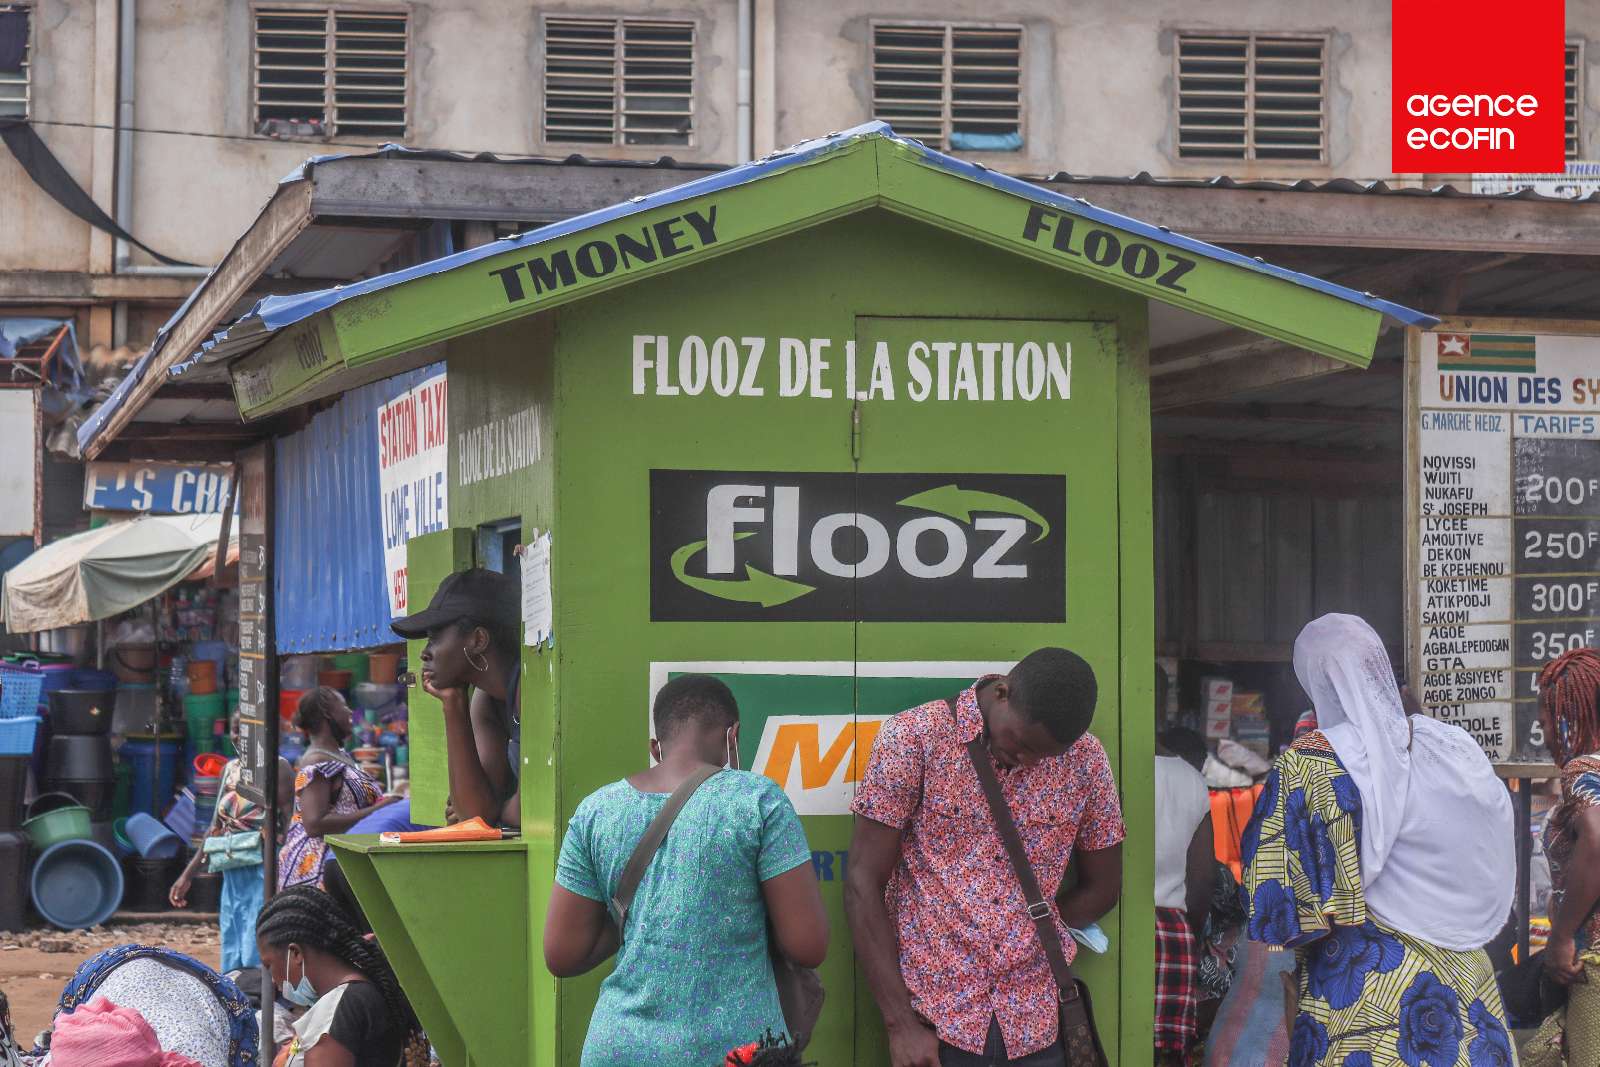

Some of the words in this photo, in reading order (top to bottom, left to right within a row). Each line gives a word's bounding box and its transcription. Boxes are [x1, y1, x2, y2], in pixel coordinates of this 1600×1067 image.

[489, 205, 718, 303] TMONEY
[1023, 205, 1196, 294] FLOOZ
[632, 335, 766, 397] FLOOZ
[778, 337, 833, 398] DE
[846, 340, 895, 401] LA
[907, 341, 1072, 402] STATION
[1439, 375, 1508, 404] UNION
[1518, 377, 1561, 404] DES
[380, 394, 418, 469] STATION
[1518, 415, 1595, 434] TARIFS
[483, 422, 494, 480] DE
[496, 419, 507, 476] LA
[1424, 472, 1461, 485] WUITI
[1425, 487, 1473, 500] NUKAFU
[414, 471, 443, 536] VILLE
[1439, 502, 1488, 516] JOSEPH
[1426, 518, 1468, 531] LYCEE
[1422, 533, 1484, 546] AMOUTIVE
[1428, 548, 1471, 561] DEKON
[1424, 564, 1437, 577] BE
[1441, 562, 1504, 577] KPEHENOU
[1427, 579, 1488, 593] KOKETIME
[1427, 594, 1491, 608] ATIKPODJI
[1423, 610, 1470, 624] SAKOMI
[1428, 626, 1465, 639] AGOE
[1423, 638, 1509, 655] AGBALEPEDOGAN
[1427, 657, 1465, 671] GTA
[1424, 673, 1452, 687] AGOE
[1455, 670, 1503, 685] ASSIYEYE
[1424, 688, 1453, 703] AGOE
[1457, 686, 1496, 701] ZONGO
[1428, 704, 1466, 718] TOTI
